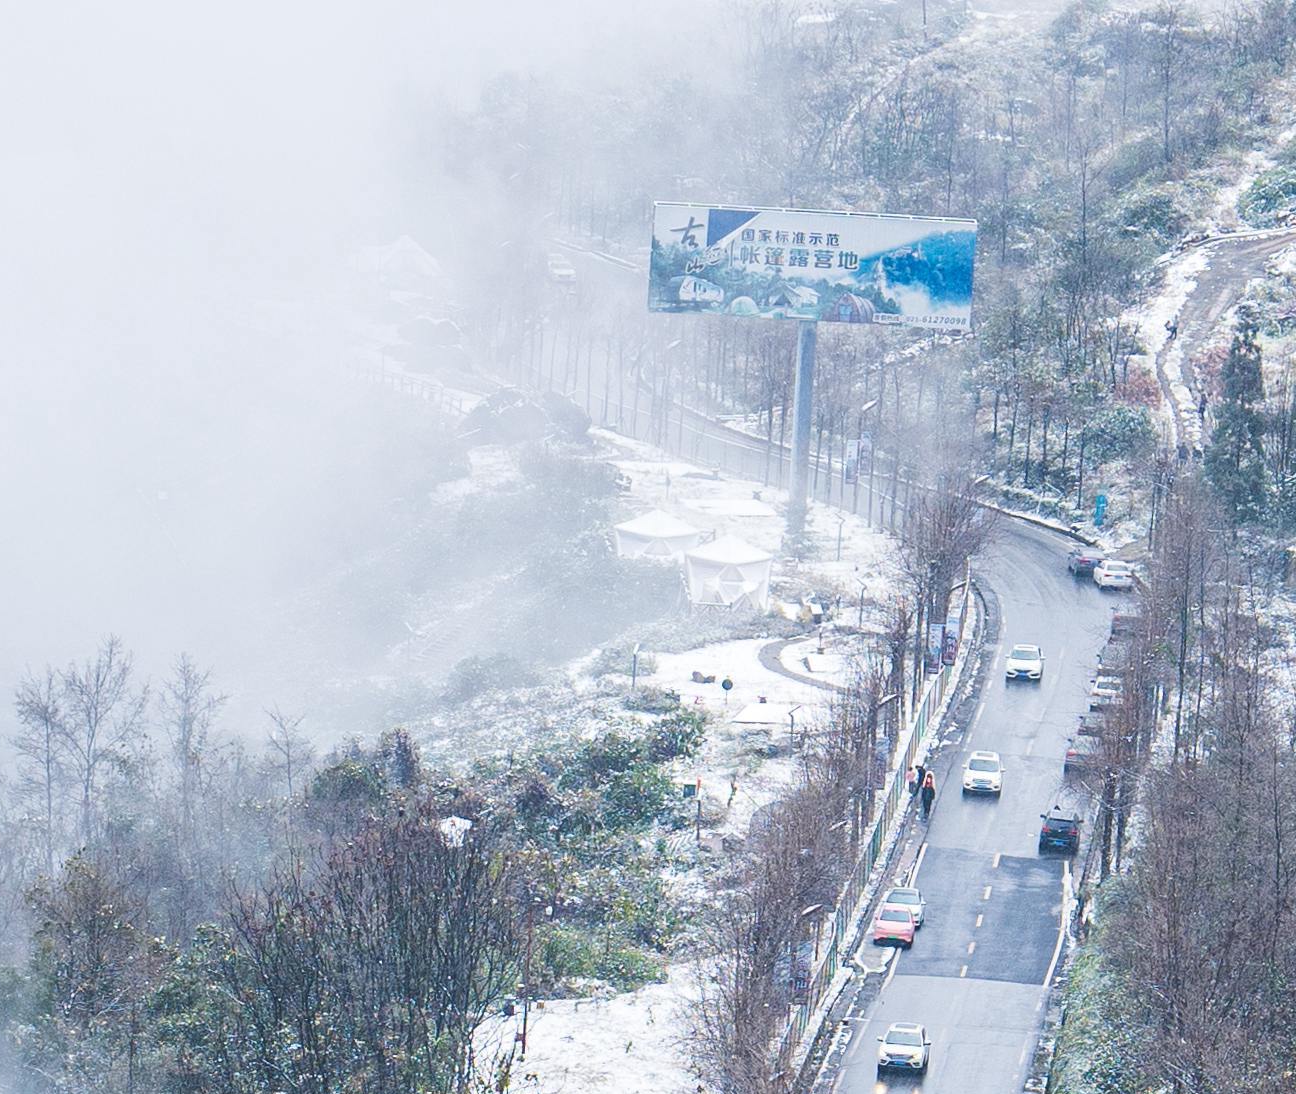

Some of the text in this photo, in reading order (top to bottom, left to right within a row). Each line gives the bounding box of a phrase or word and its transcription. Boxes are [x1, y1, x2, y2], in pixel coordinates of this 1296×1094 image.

[742, 228, 840, 246] 国家标准示范
[740, 245, 858, 270] 帐篷露营地
